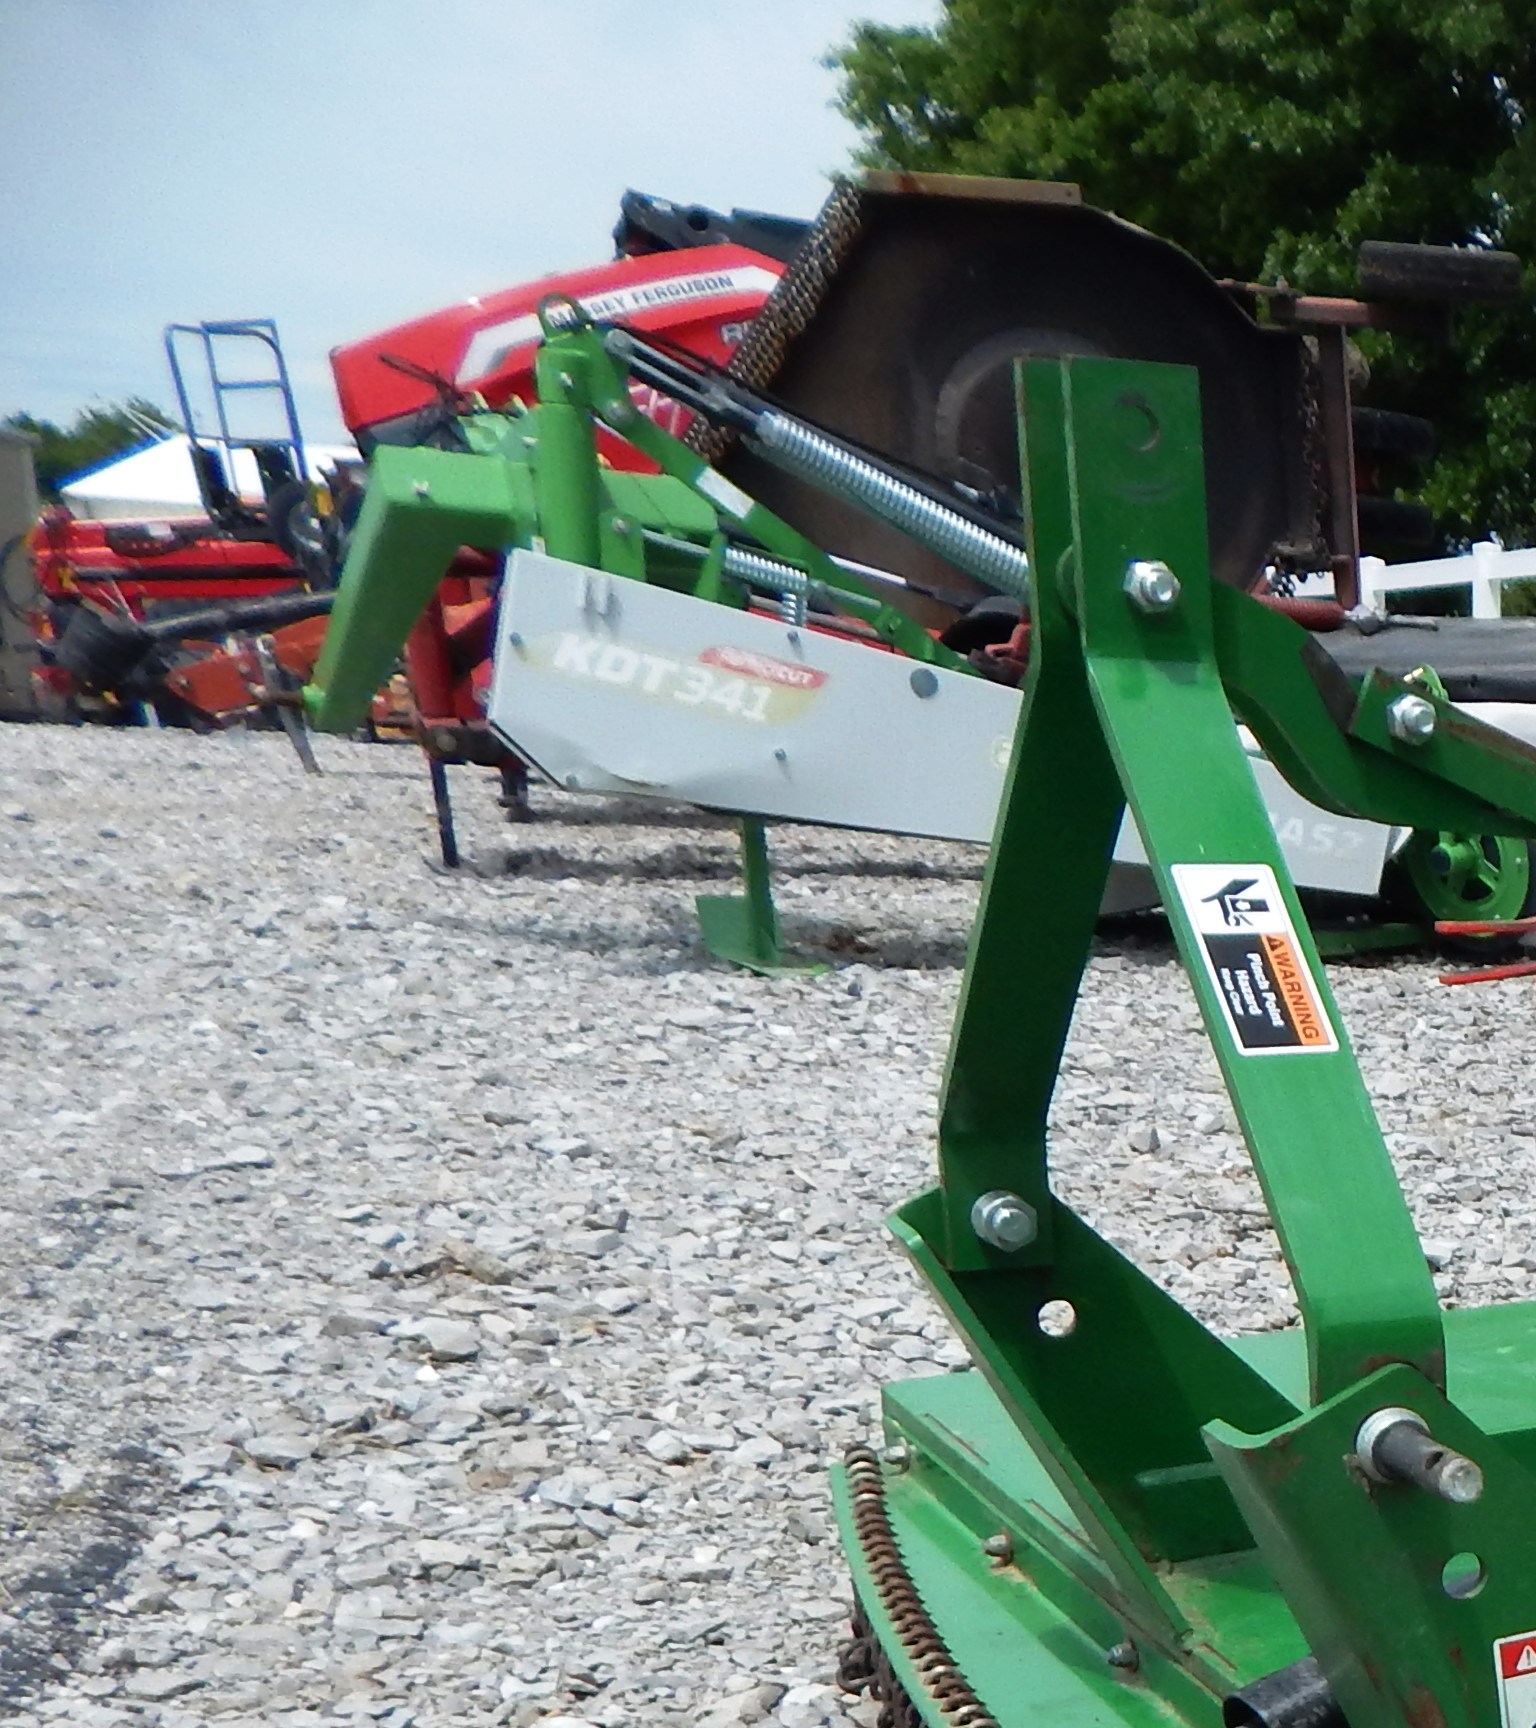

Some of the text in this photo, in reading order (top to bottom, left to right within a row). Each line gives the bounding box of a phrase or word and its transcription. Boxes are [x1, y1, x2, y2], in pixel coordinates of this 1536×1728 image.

[549, 276, 735, 329] MASEY FERGUSON
[1235, 970, 1262, 1015] Hazard
[1247, 953, 1285, 1026] Pinch Point
[1274, 951, 1319, 1039] WARNING
